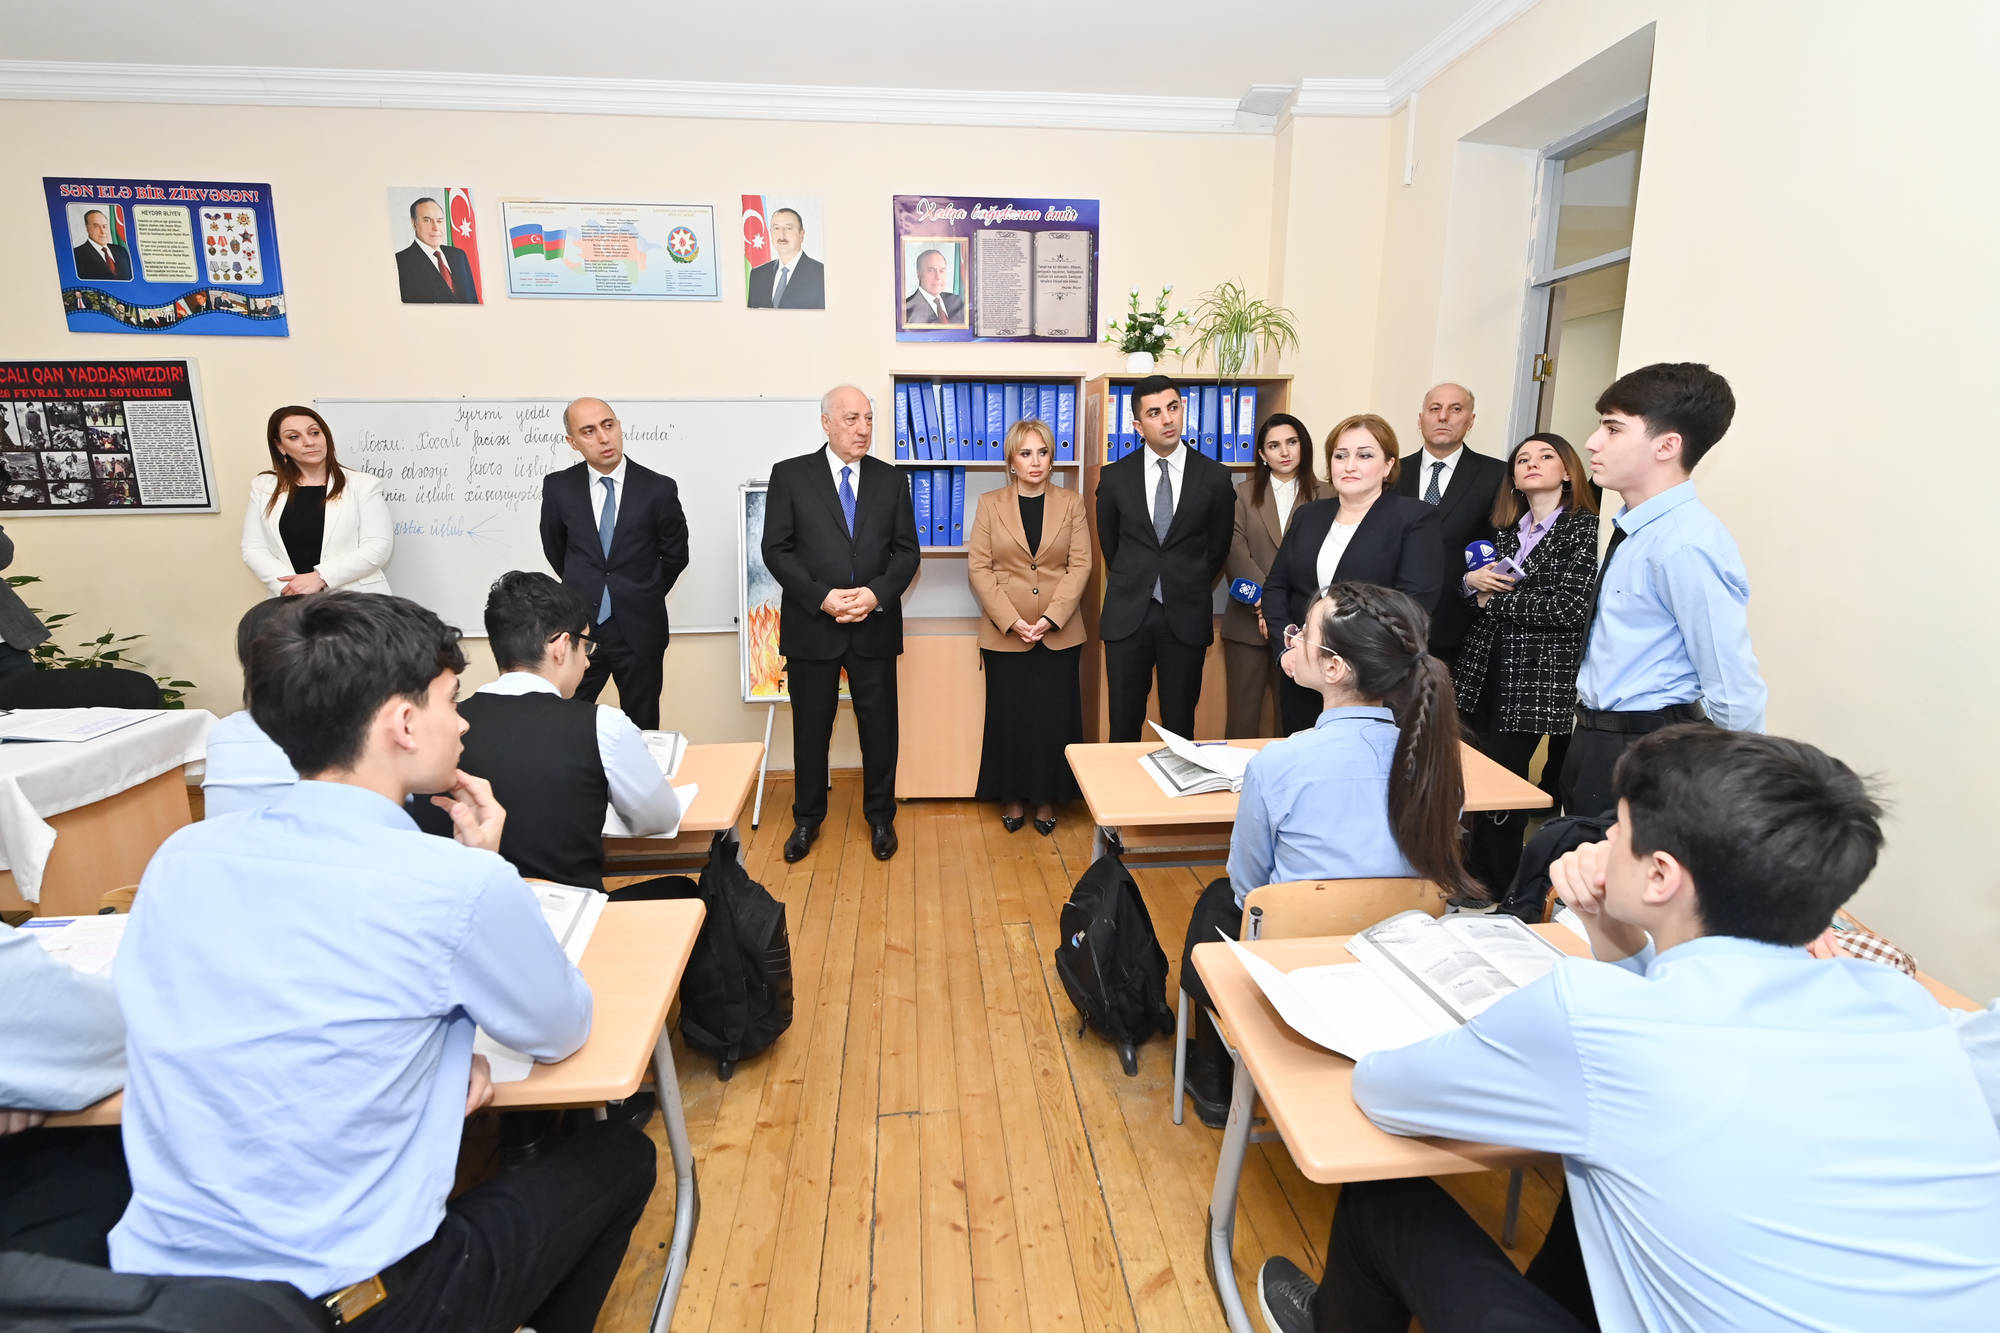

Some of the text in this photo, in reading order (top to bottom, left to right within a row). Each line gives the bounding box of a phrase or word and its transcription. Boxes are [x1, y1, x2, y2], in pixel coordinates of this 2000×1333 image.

[60, 184, 260, 202] SƏN ELƏ BİR ZİRVƏSƏN!
[916, 197, 968, 226] Xalqa
[0, 366, 184, 386] CALI QAN YADDAŞIMIZDIR!
[14, 388, 62, 398] FEVRAL
[64, 388, 107, 398] XOCALI
[109, 387, 173, 398] SOYQIRIMI
